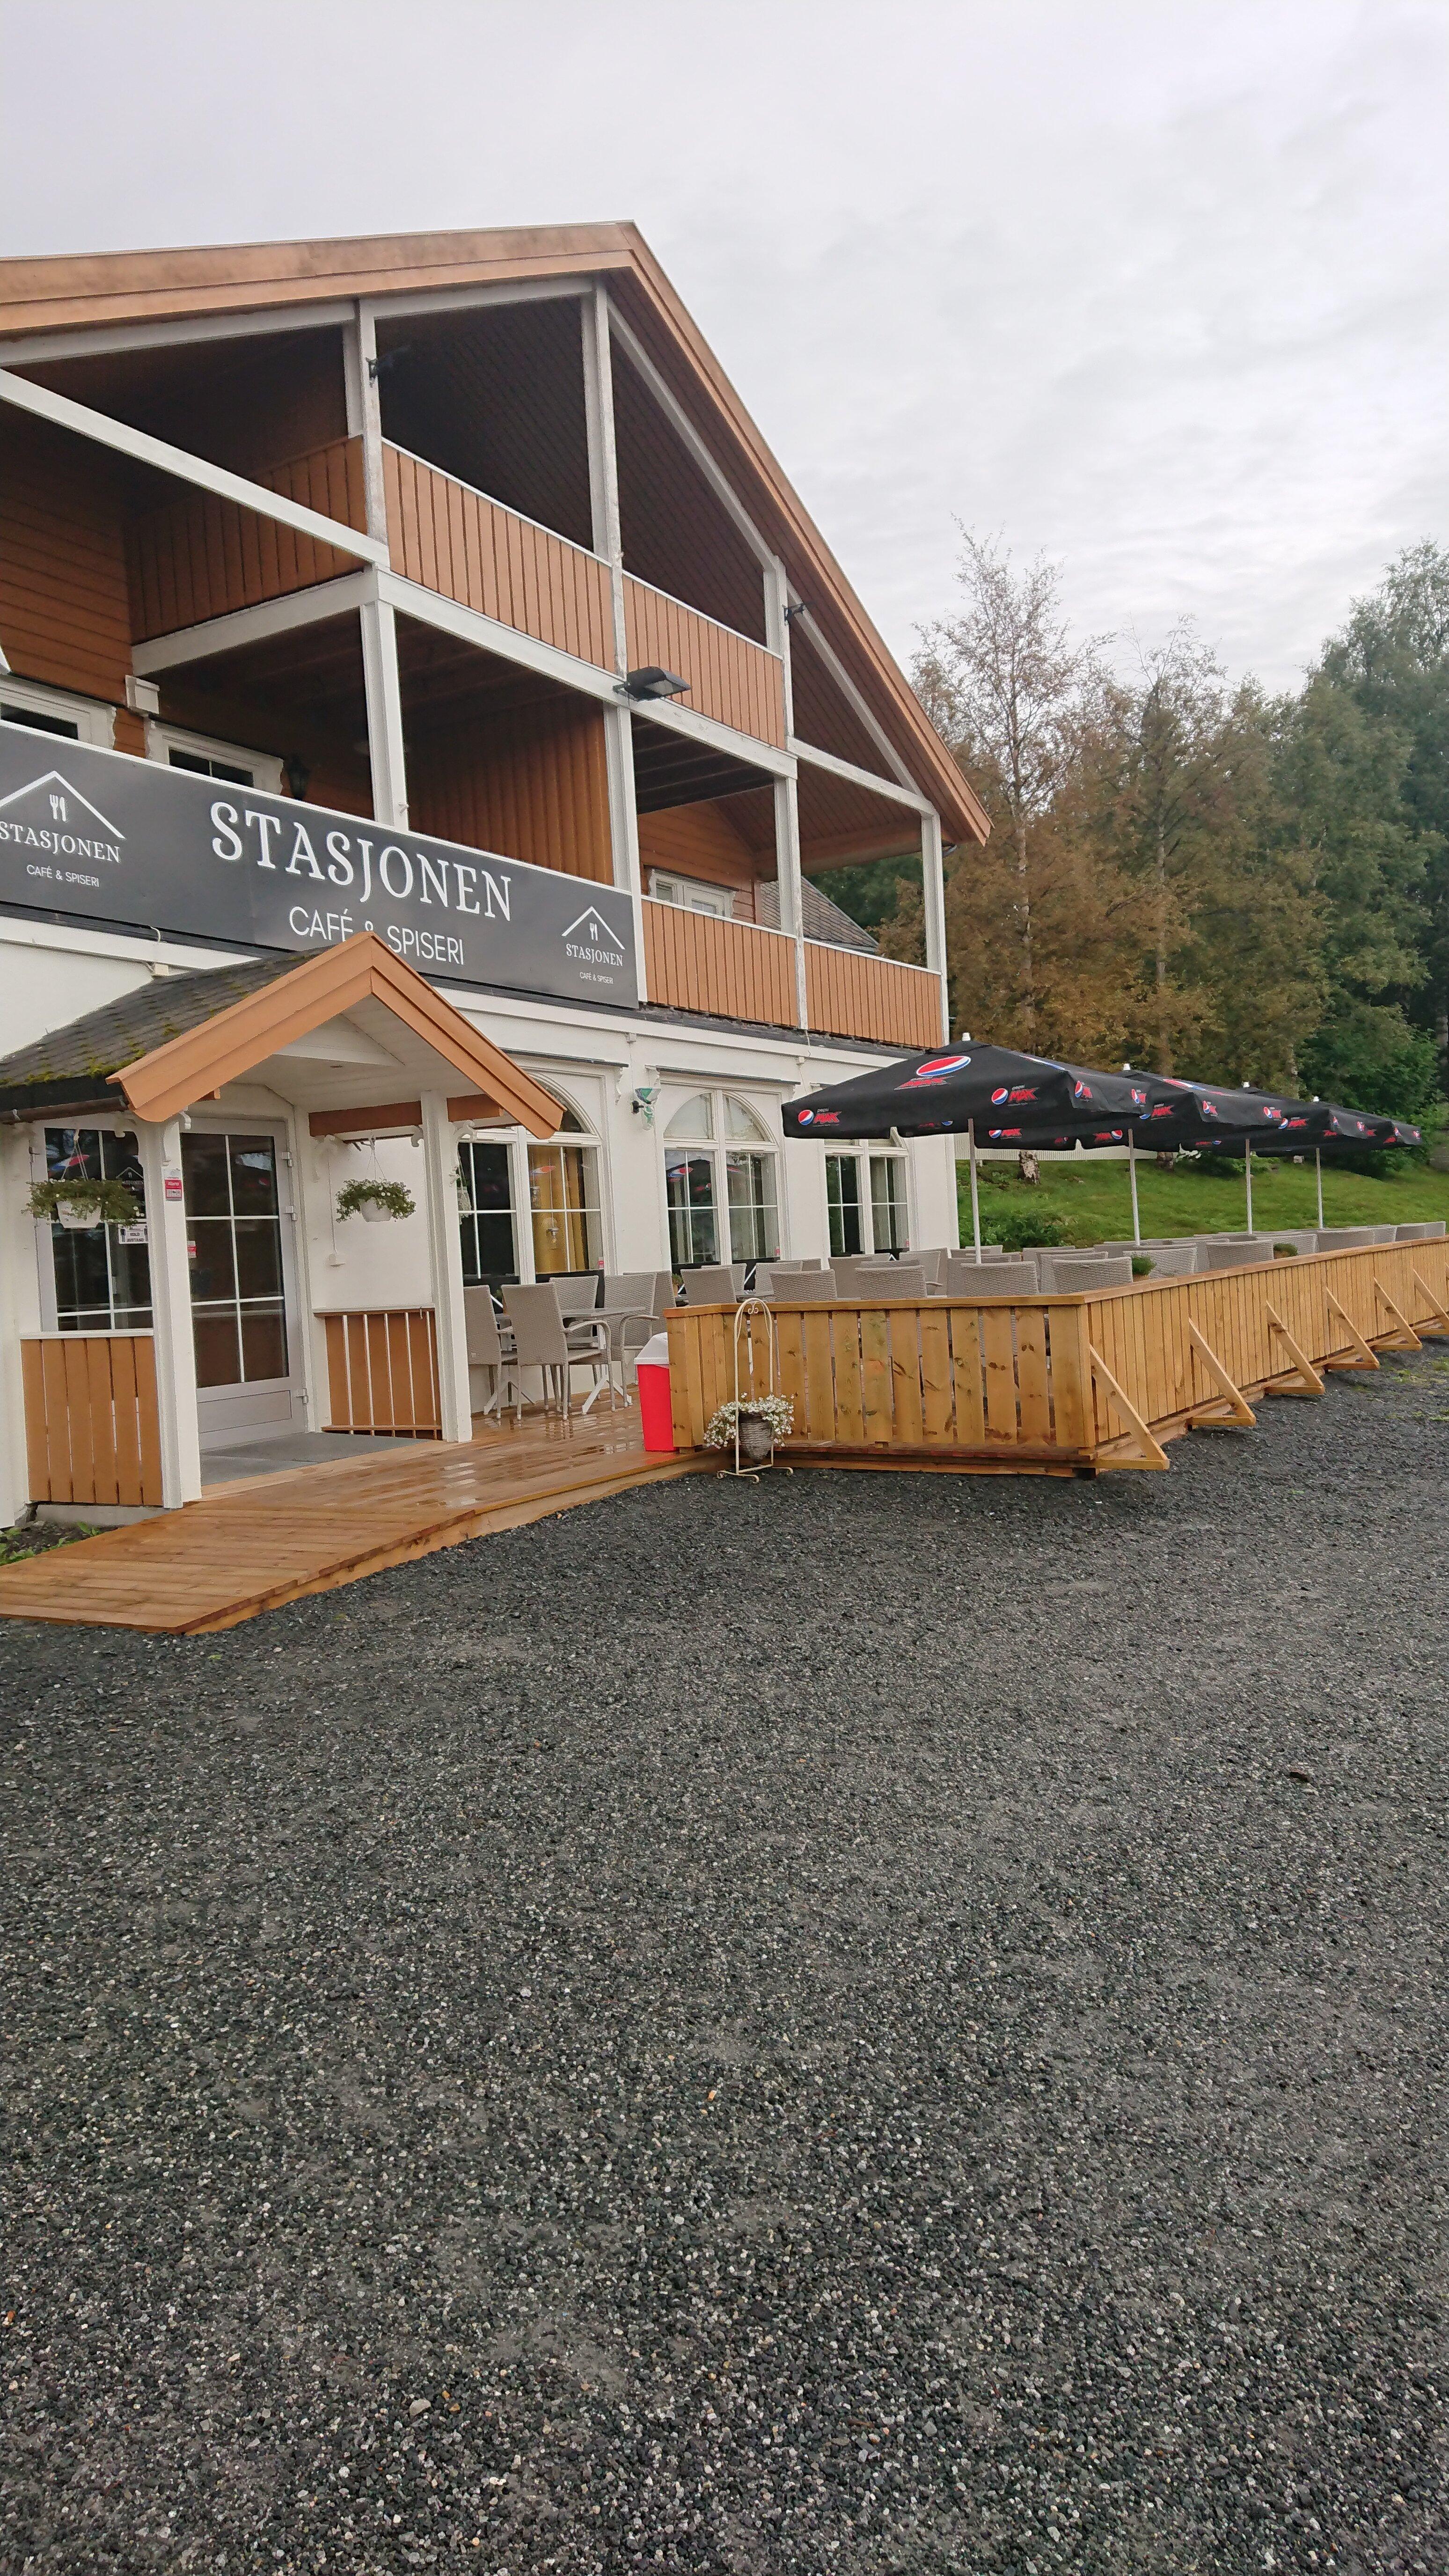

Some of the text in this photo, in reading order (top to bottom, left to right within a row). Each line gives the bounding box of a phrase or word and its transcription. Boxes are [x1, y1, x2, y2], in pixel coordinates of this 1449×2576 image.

[0, 821, 121, 863] STASJONEN
[211, 802, 511, 922] STASJONEN
[27, 864, 100, 887] CAFÉ & SPISERI
[289, 906, 464, 965] CAFÉ SPISERI
[566, 944, 623, 966] STASJONEN
[579, 972, 592, 981] CAFÉ
[597, 975, 614, 984] SPISERI
[1008, 1087, 1040, 1103] MAX
[813, 1111, 842, 1124] MAX
